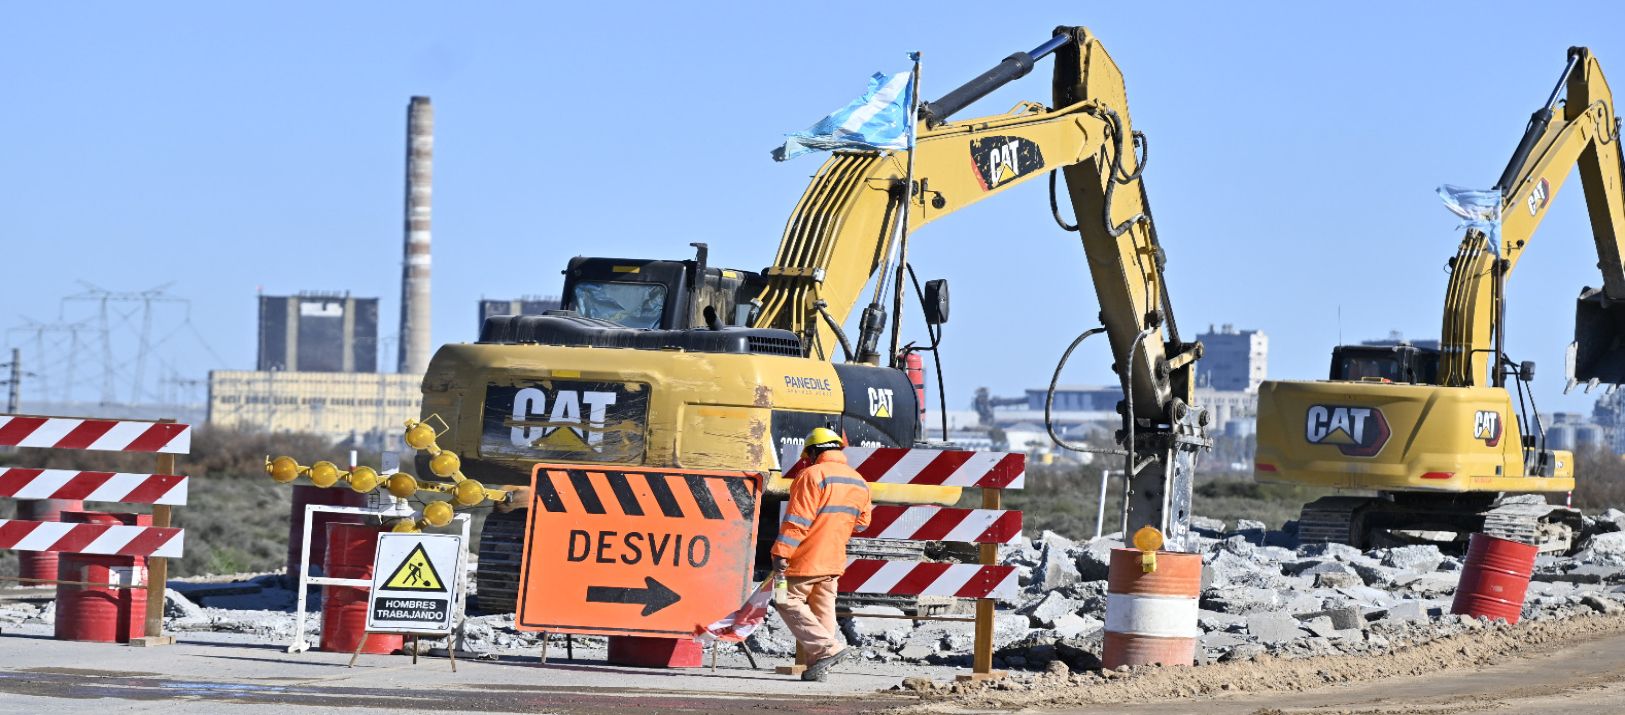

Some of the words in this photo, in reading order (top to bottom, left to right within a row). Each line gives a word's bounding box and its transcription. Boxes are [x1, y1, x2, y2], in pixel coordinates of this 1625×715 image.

[990, 140, 1019, 188] CAT
[1528, 180, 1545, 216] CAT
[784, 376, 831, 391] PANEDILE
[868, 387, 893, 418] CAT
[511, 387, 616, 453] CAT
[1307, 405, 1371, 445] CAT
[1474, 411, 1497, 439] CAT
[567, 530, 710, 568] DESVIO
[377, 609, 443, 620] TRABAJANDO
[385, 600, 436, 609] HOMBRES
